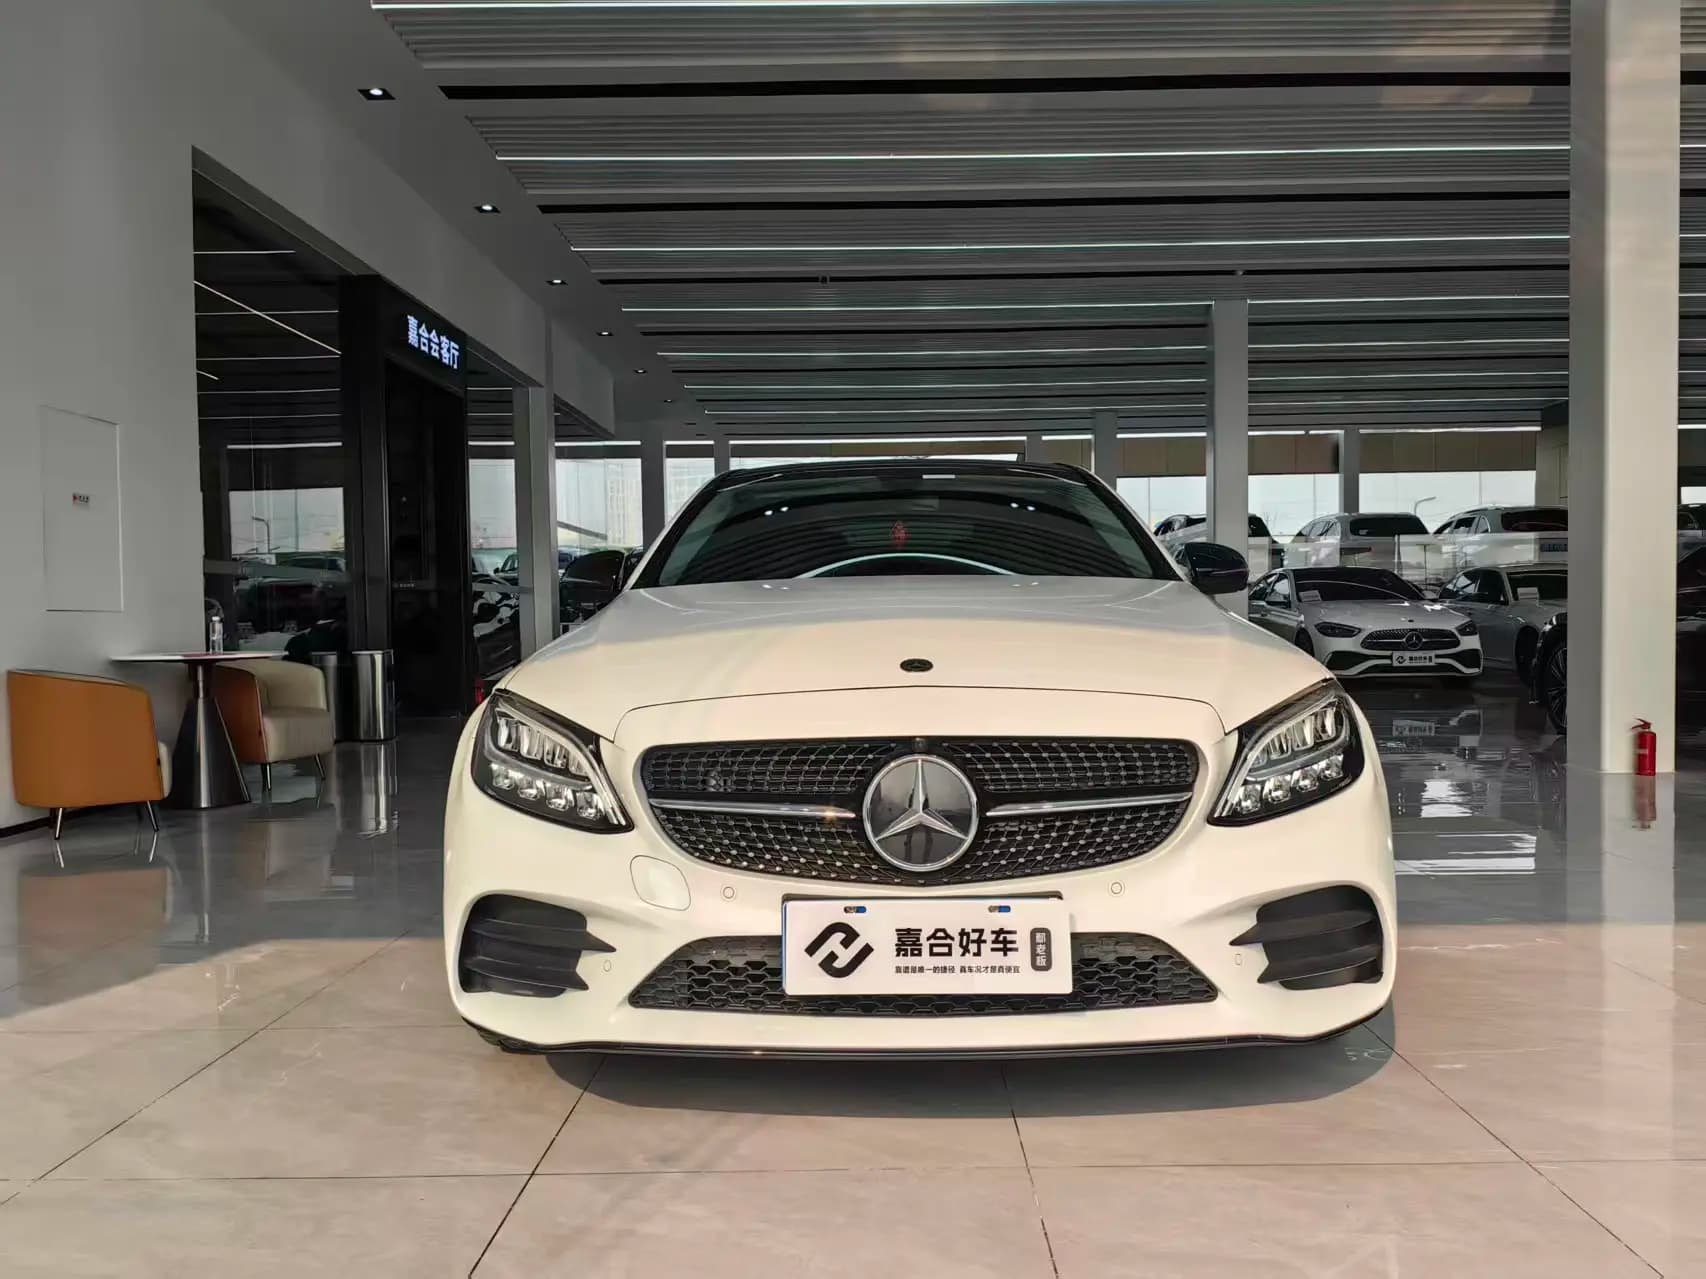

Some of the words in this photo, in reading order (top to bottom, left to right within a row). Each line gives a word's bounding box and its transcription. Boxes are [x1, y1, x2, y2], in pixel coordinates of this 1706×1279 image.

[407, 314, 460, 369] 嘉合会客厅
[894, 927, 1019, 957] 嘉合好车
